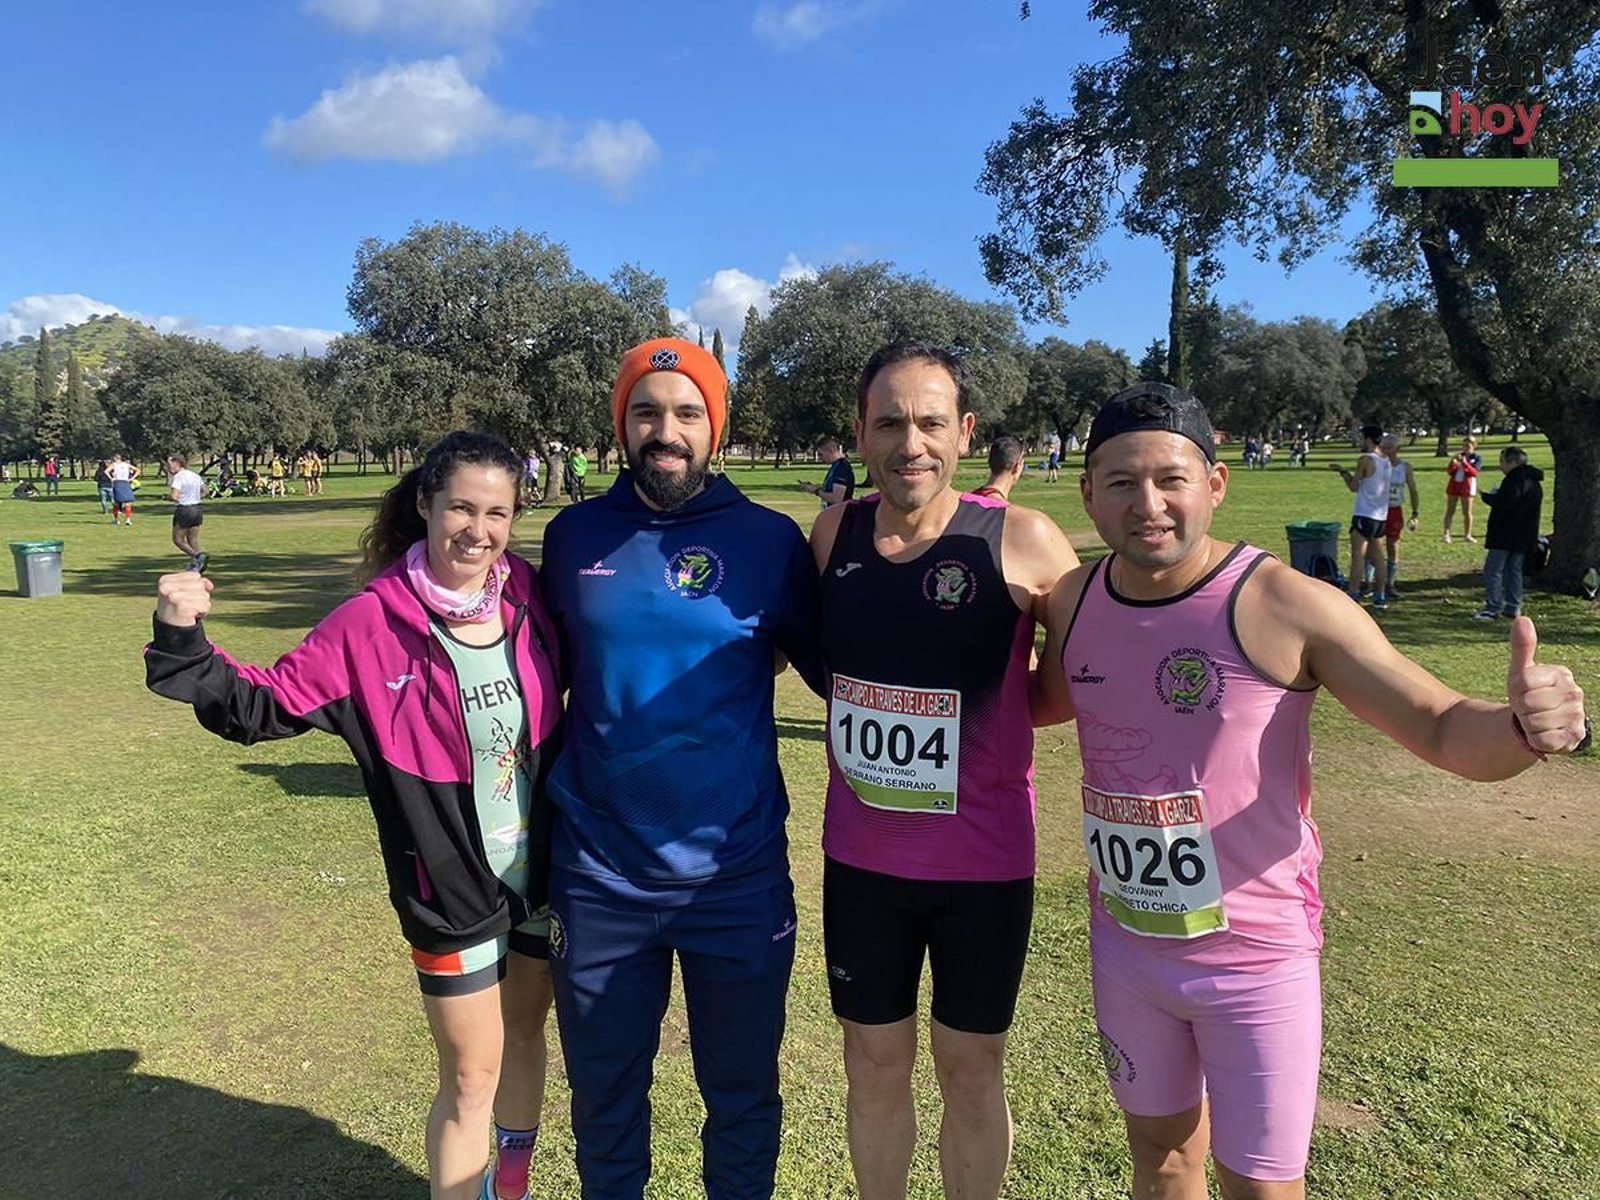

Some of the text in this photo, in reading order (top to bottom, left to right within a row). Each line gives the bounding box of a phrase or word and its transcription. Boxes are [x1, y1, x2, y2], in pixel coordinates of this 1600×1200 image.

[916, 694, 927, 715] LA
[838, 712, 949, 770] 1004
[844, 766, 937, 791] SERRANO SERRANO
[857, 761, 917, 777] JUAN ANTONIO
[1164, 796, 1202, 825] GARZA
[1090, 828, 1206, 887] 1026
[1151, 901, 1188, 913] CHICA
